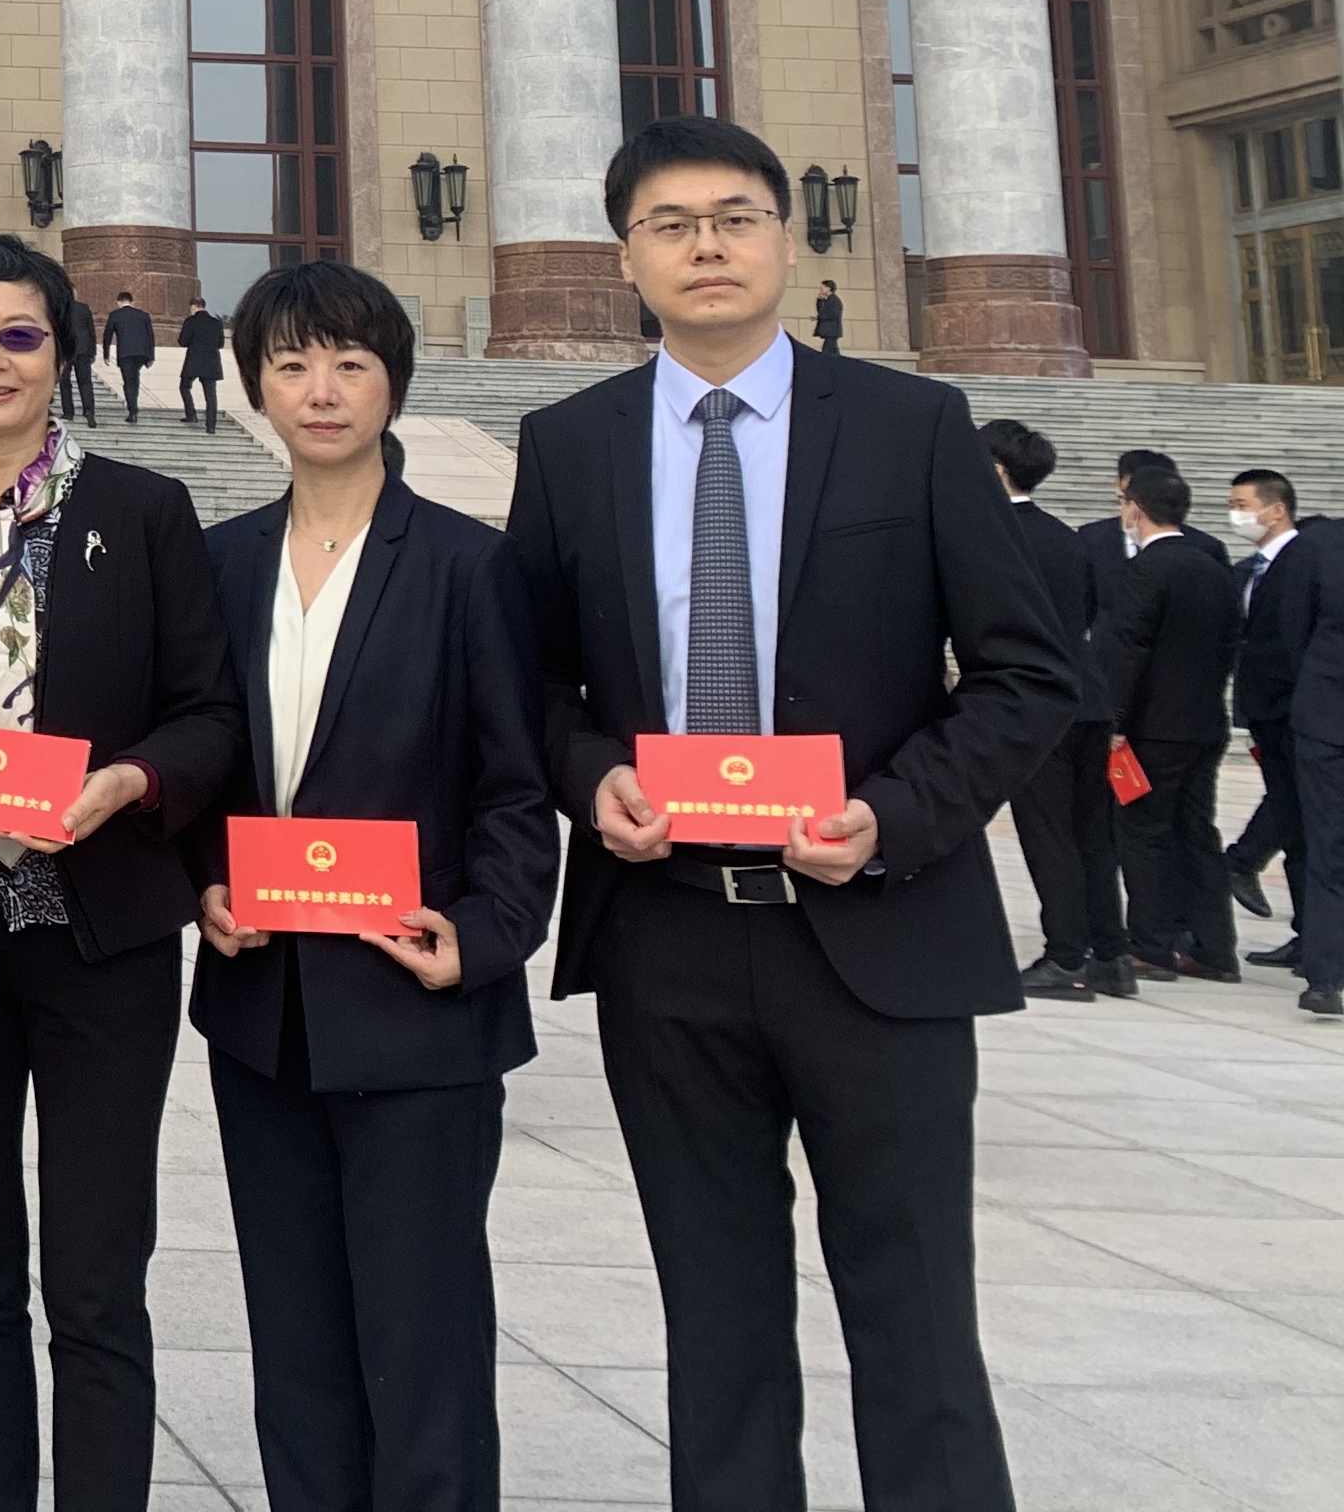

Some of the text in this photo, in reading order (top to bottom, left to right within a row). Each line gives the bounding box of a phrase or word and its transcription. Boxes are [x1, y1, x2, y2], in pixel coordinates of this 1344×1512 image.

[665, 800, 816, 818] 国家科学技术奖励大会
[256, 888, 393, 906] 国家科学技术奖励大会
